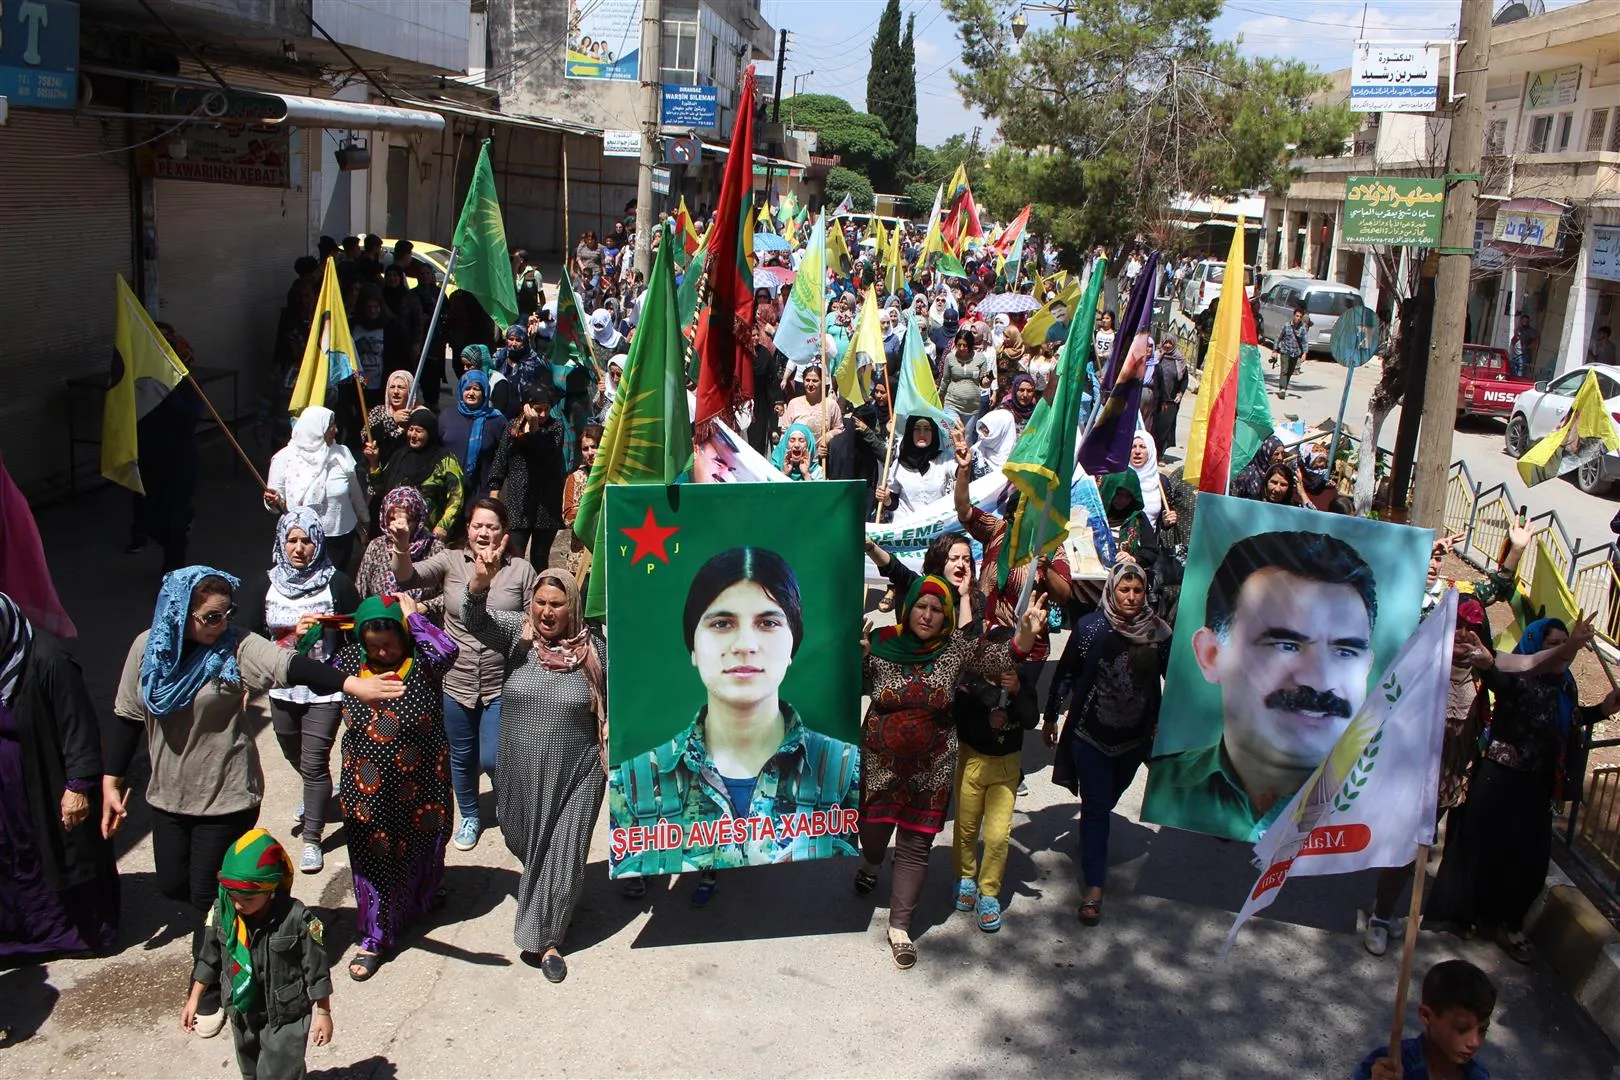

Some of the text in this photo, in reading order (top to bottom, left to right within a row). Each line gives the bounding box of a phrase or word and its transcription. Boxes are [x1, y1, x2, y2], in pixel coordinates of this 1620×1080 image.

[1379, 52, 1414, 64] الدكتورة
[1361, 66, 1428, 83] نسرين رشيد
[1389, 186, 1443, 207] مطهر
[1350, 208, 1374, 218] العباسي
[1397, 208, 1411, 219] شيخ
[1412, 209, 1435, 218] سليمان
[1097, 340, 1110, 351] 55
[1484, 391, 1520, 403] NISS
[902, 520, 945, 539] EMÊ
[620, 545, 628, 557] Y
[674, 542, 680, 554] J
[647, 563, 655, 574] P
[611, 803, 859, 860] ŞEHÎD AVÊSTA XABÛR
